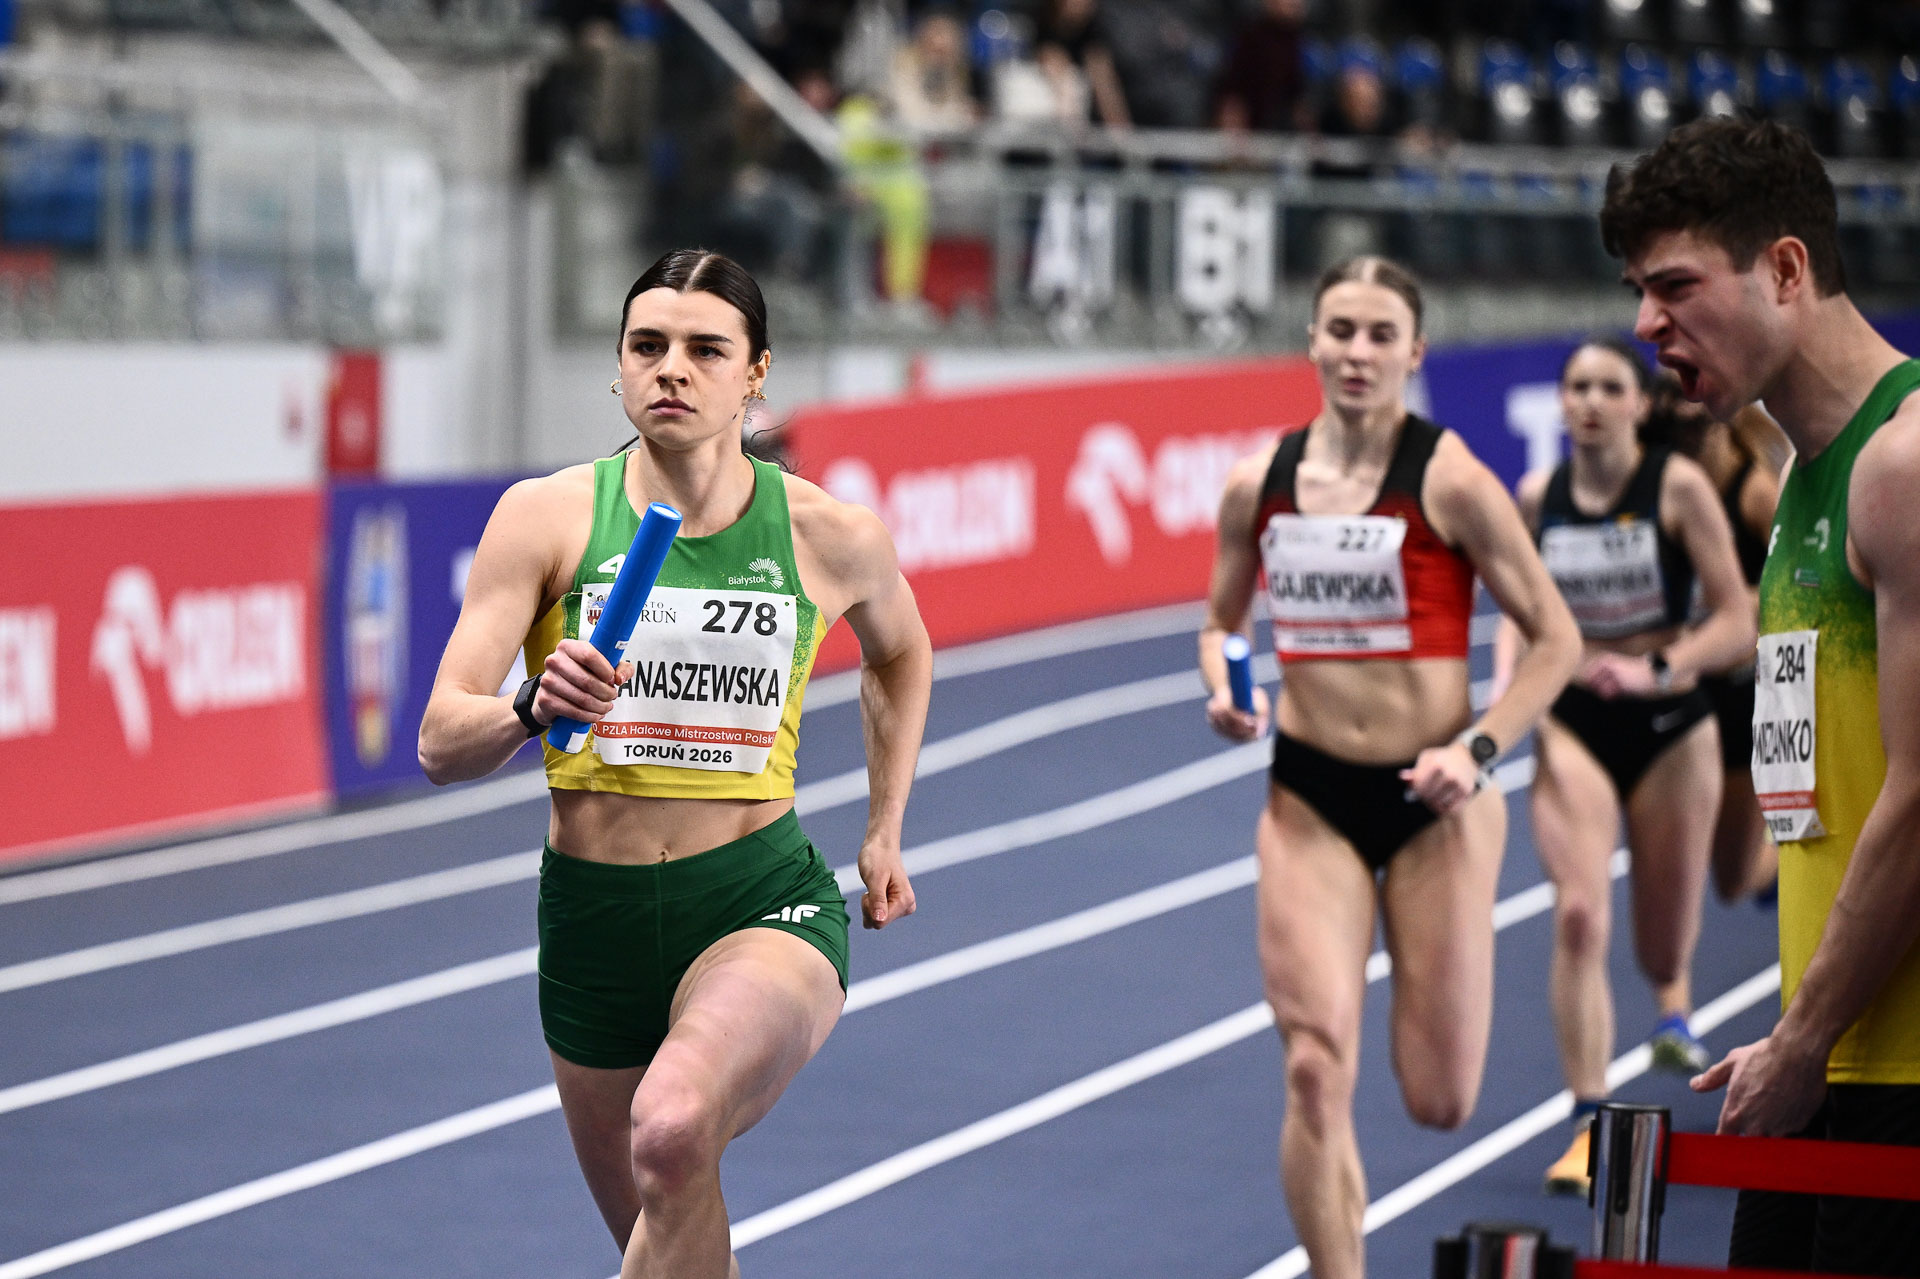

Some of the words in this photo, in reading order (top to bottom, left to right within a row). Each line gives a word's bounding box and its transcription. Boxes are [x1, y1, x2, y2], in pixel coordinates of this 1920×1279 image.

[1339, 527, 1386, 551] 227
[728, 573, 767, 586] Białystok
[641, 608, 677, 623] RUŃ
[702, 600, 777, 636] 278
[1774, 644, 1806, 684] 284
[618, 660, 780, 707] ANASZEWSKA
[603, 725, 628, 735] PZLA
[630, 725, 672, 737] Halowe
[674, 728, 742, 741] Mistrzostwa
[624, 744, 685, 760] TORUŃ
[689, 748, 733, 763] 2026
